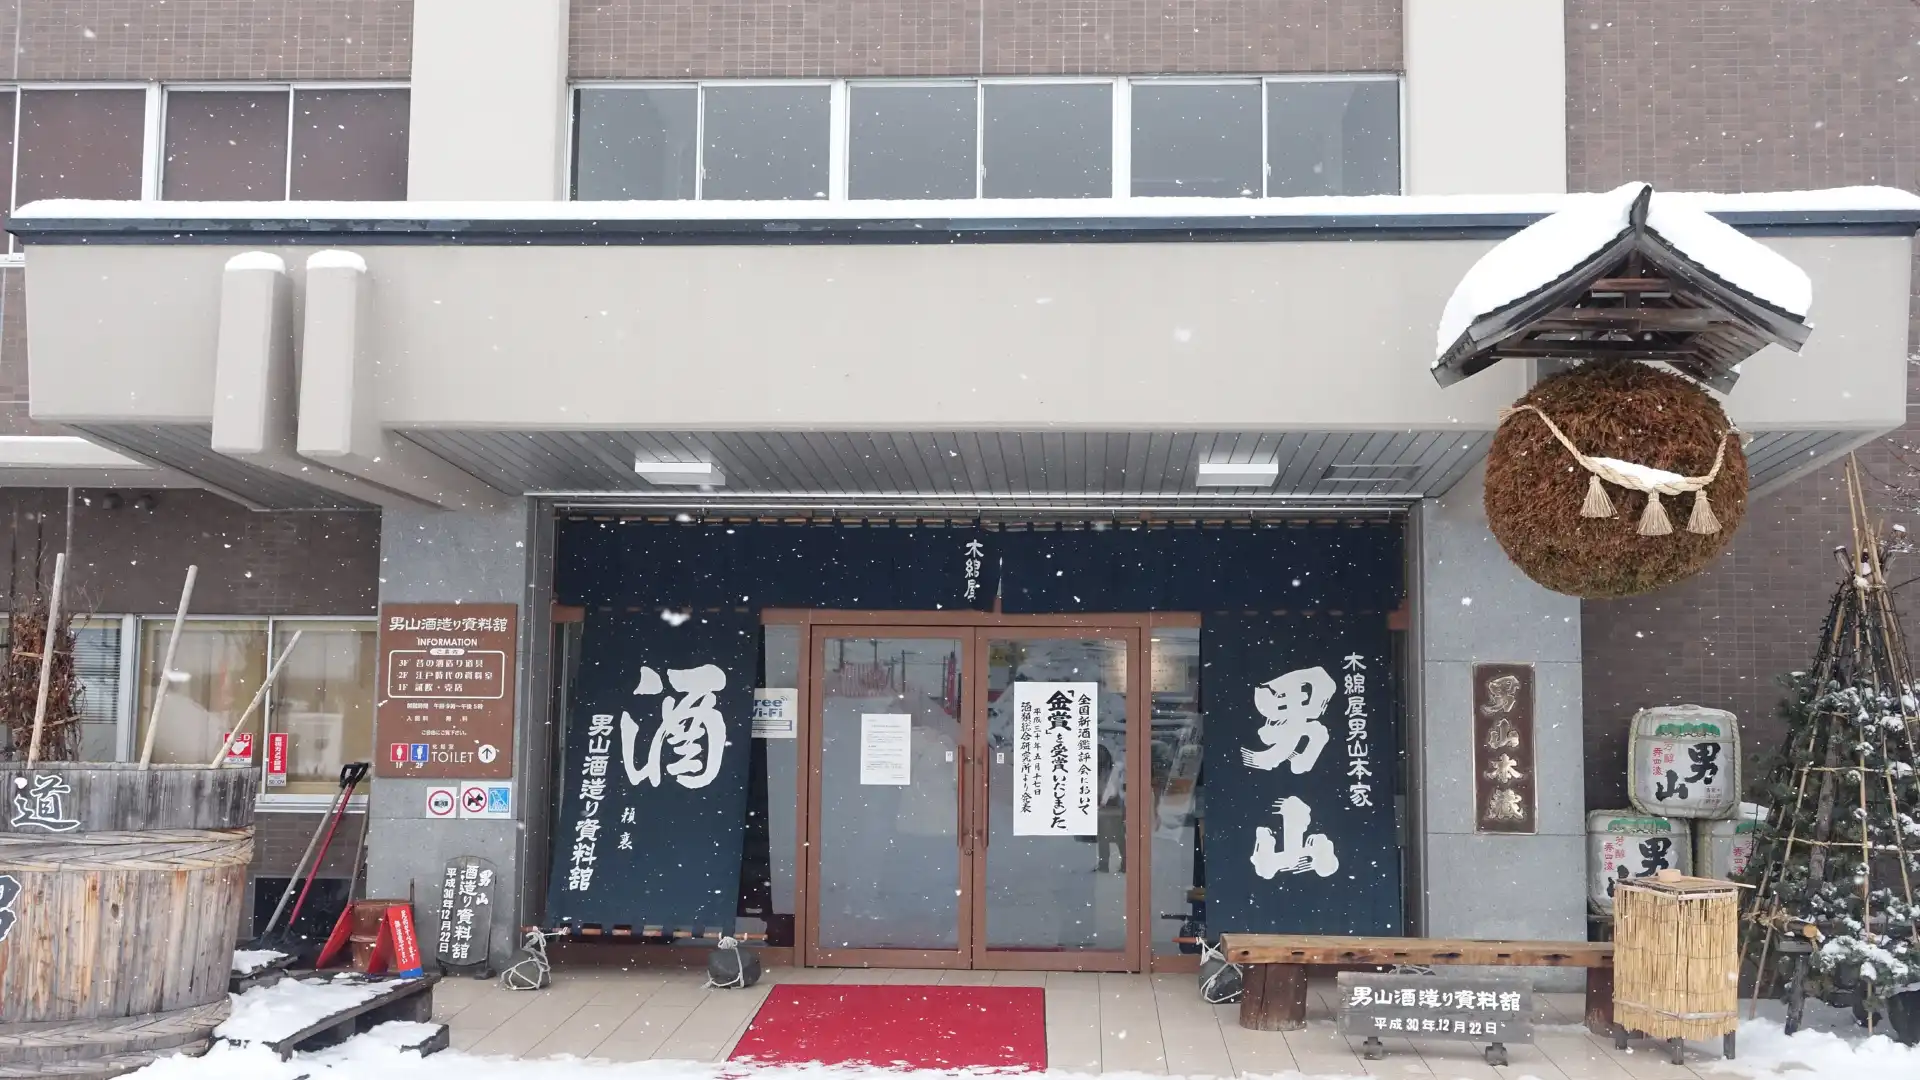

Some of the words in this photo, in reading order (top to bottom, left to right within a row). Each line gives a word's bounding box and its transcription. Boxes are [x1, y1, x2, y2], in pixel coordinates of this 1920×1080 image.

[416, 638, 478, 646] INFORMATION
[398, 660, 409, 668] 3F
[398, 672, 409, 680] 2F
[754, 699, 782, 707] ree
[620, 664, 727, 789] 酒
[1343, 652, 1373, 807] 木綿屋男山本家
[431, 752, 474, 763] TOILET
[1240, 666, 1340, 880] 男山
[476, 869, 494, 905] 男山
[439, 868, 457, 953] 平成30年12月22日
